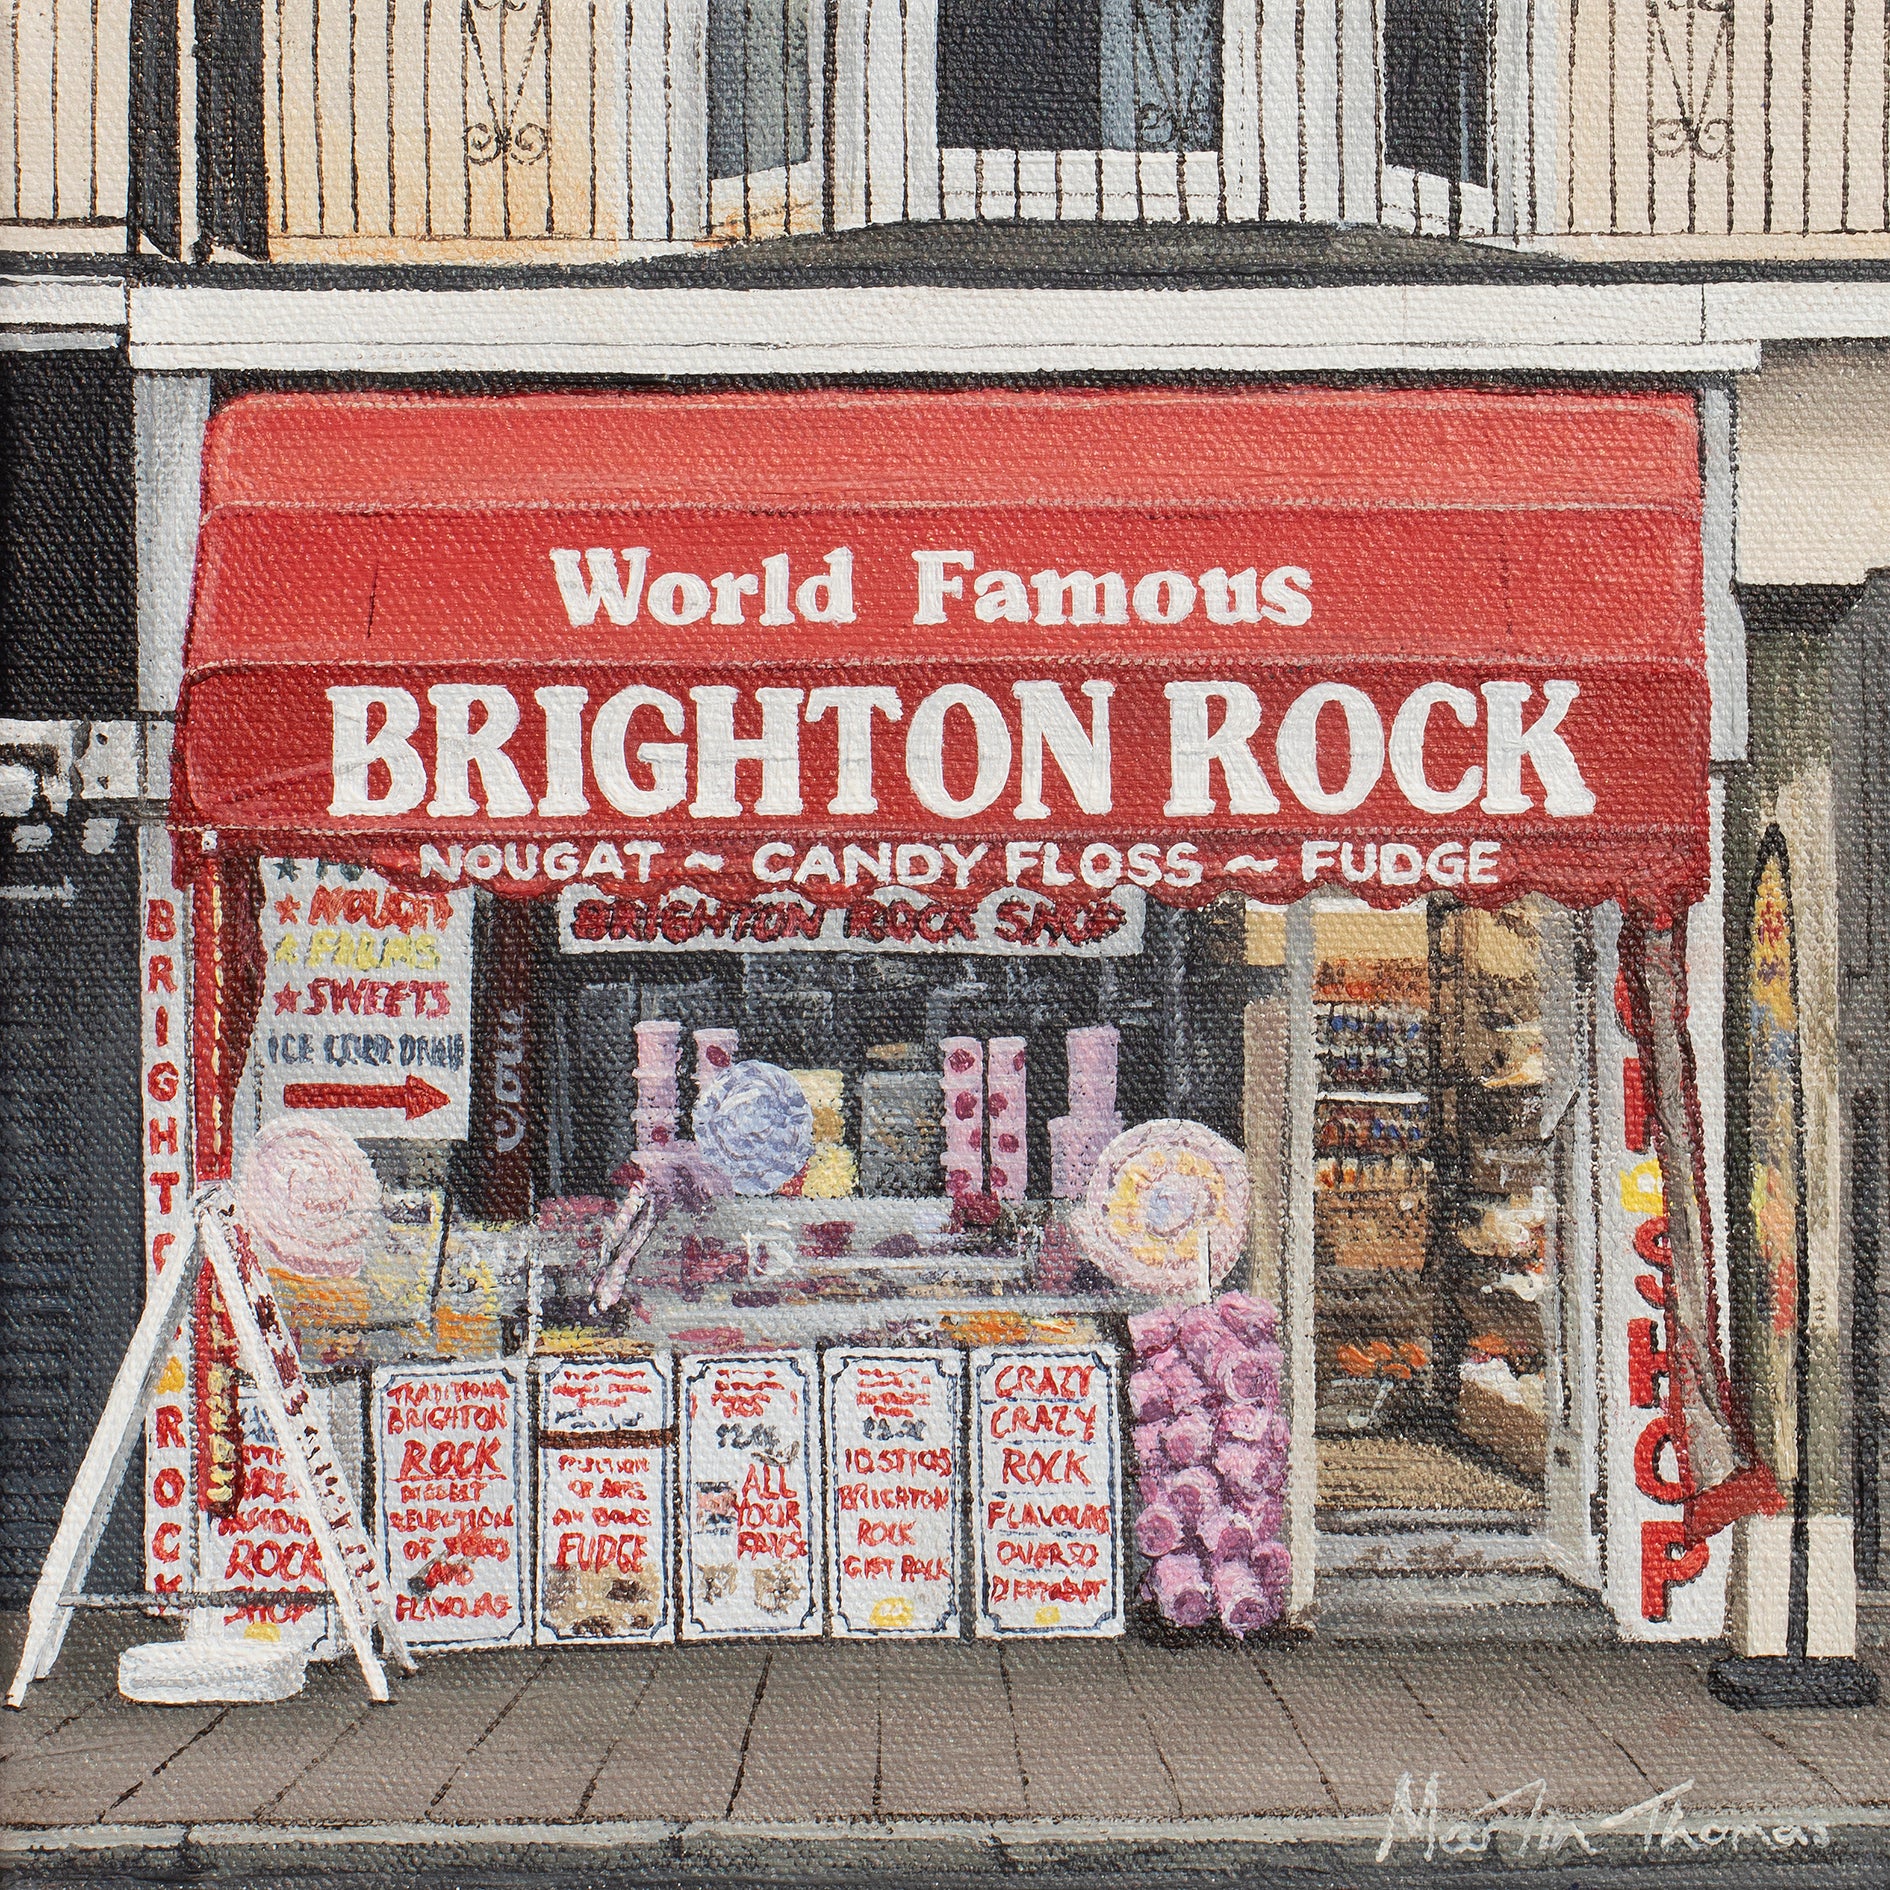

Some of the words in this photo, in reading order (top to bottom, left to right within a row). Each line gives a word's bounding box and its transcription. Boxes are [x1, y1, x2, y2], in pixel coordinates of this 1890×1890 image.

[549, 546, 857, 629] World
[911, 549, 1313, 626] Famous
[326, 680, 1114, 821] BRIGHTON
[1163, 680, 1598, 818] ROCK
[419, 841, 665, 883] NOUGAT
[752, 841, 989, 890] CANDY
[1004, 841, 1203, 889] FLOSS
[1301, 840, 1501, 884] FUDGE
[572, 898, 827, 945] BRIGHTON
[843, 898, 981, 945] ROCK
[301, 976, 451, 1020] SWEETS
[995, 1364, 1097, 1400] CRAZY
[387, 1402, 509, 1436] BRIGHTON
[990, 1403, 1098, 1442] CRAZY
[400, 1436, 504, 1478] ROCK
[1002, 1447, 1093, 1489] ROCK
[741, 1462, 798, 1500] ALL
[731, 1496, 803, 1532] YOUR
[556, 1532, 649, 1575] FUDGE
